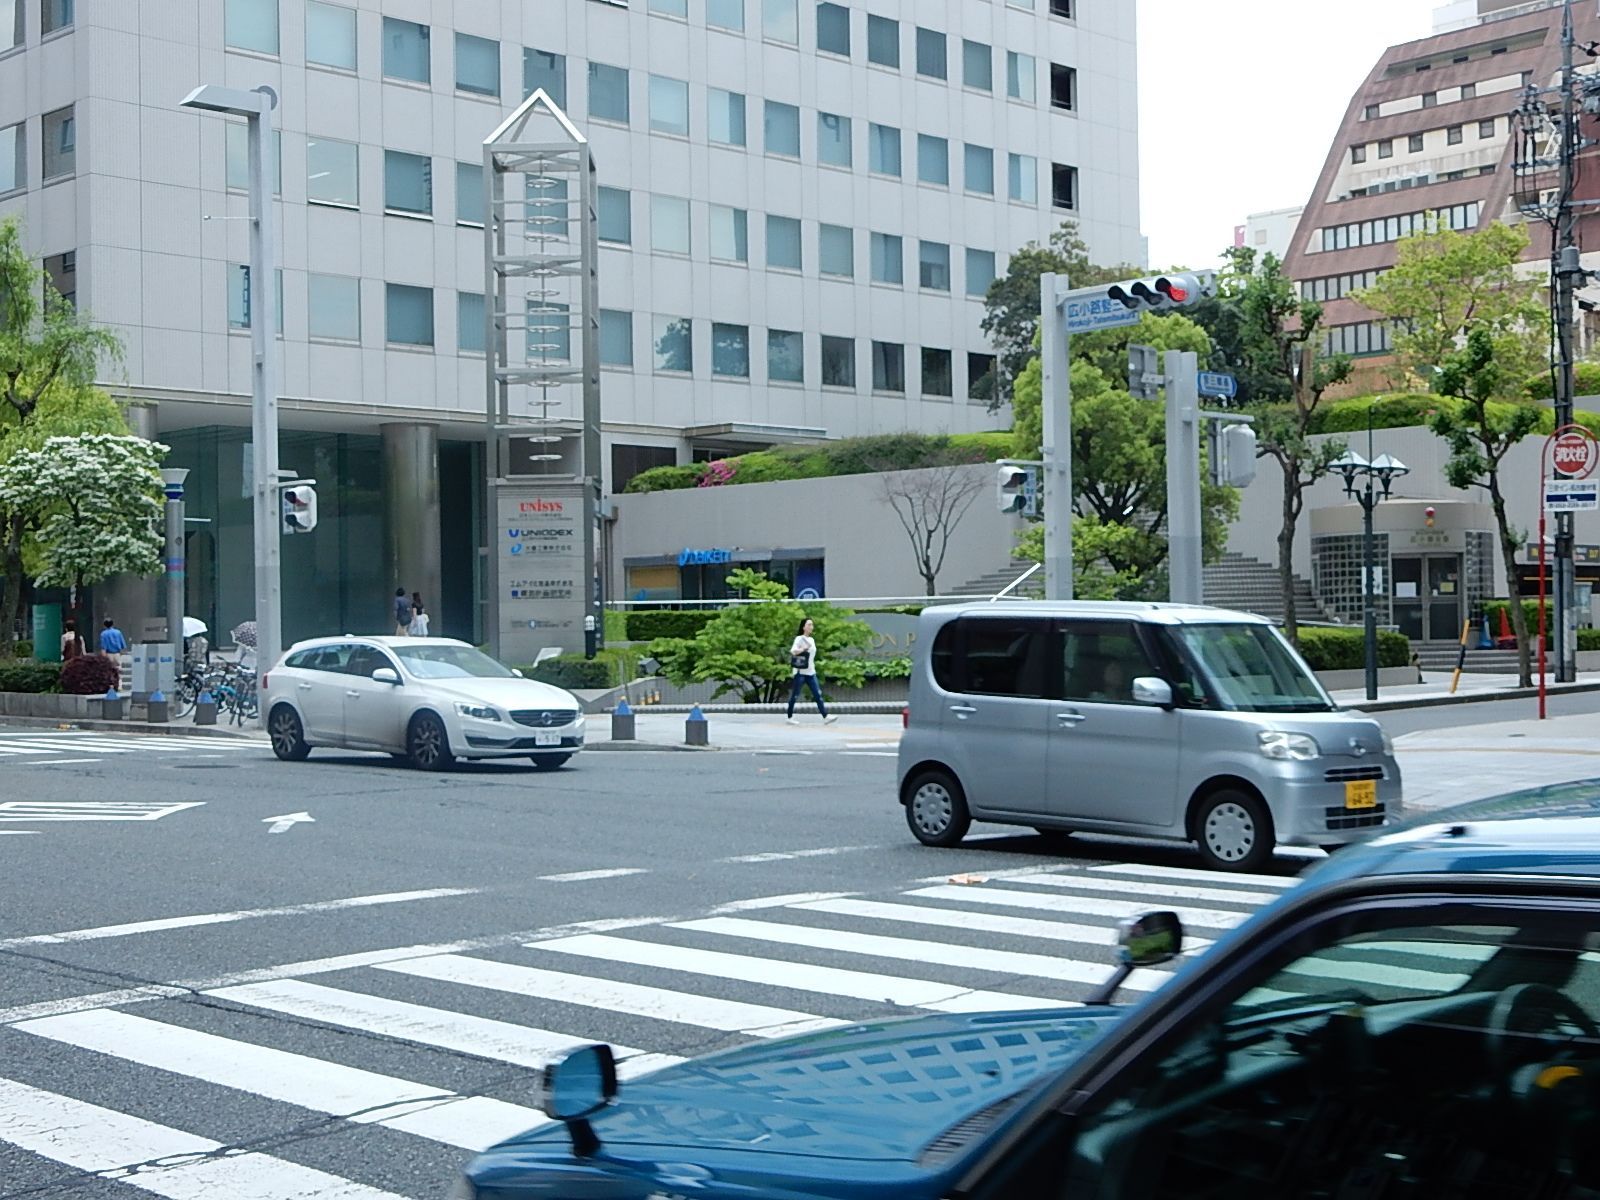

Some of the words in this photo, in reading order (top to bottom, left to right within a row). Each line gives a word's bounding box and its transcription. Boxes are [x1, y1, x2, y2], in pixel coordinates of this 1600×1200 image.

[1068, 298, 1123, 318] 広小路竪三
[1555, 446, 1587, 462] 消火栓
